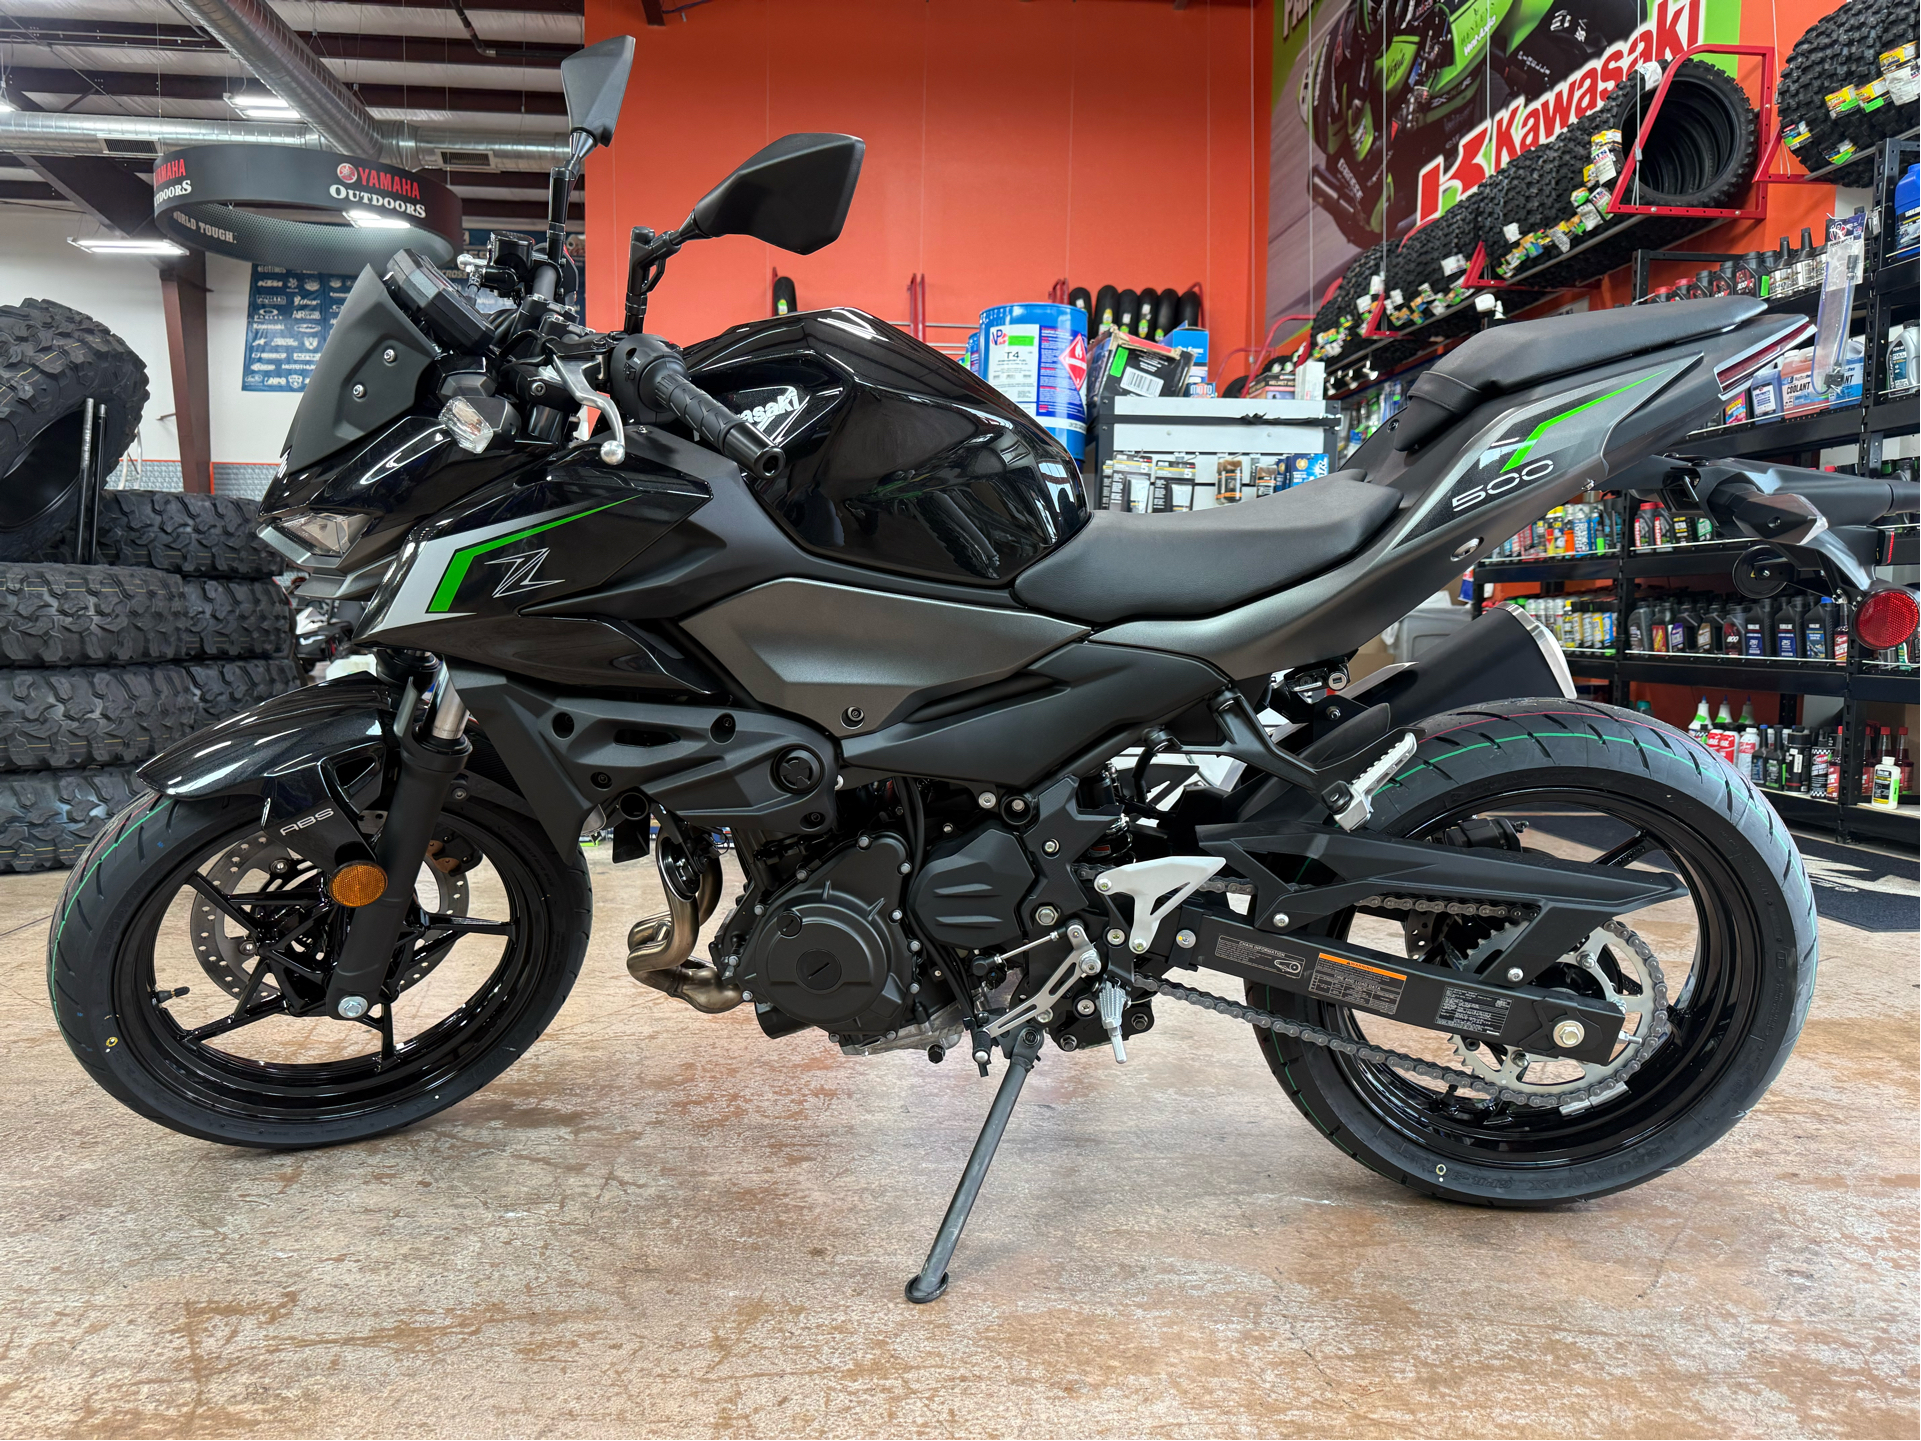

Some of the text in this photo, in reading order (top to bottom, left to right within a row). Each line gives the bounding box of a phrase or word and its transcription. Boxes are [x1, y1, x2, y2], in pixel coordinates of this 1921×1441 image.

[1494, 0, 1702, 174] Kawasaki
[358, 167, 421, 200] YAMAHA
[329, 184, 427, 219] OUTDOORS
[1005, 351, 1020, 359] T4
[1190, 383, 1213, 395] MOTO
[1786, 381, 1811, 396] COOLANT
[738, 395, 800, 423] asaki
[1451, 459, 1554, 512] 500
[279, 807, 335, 836] ABS
